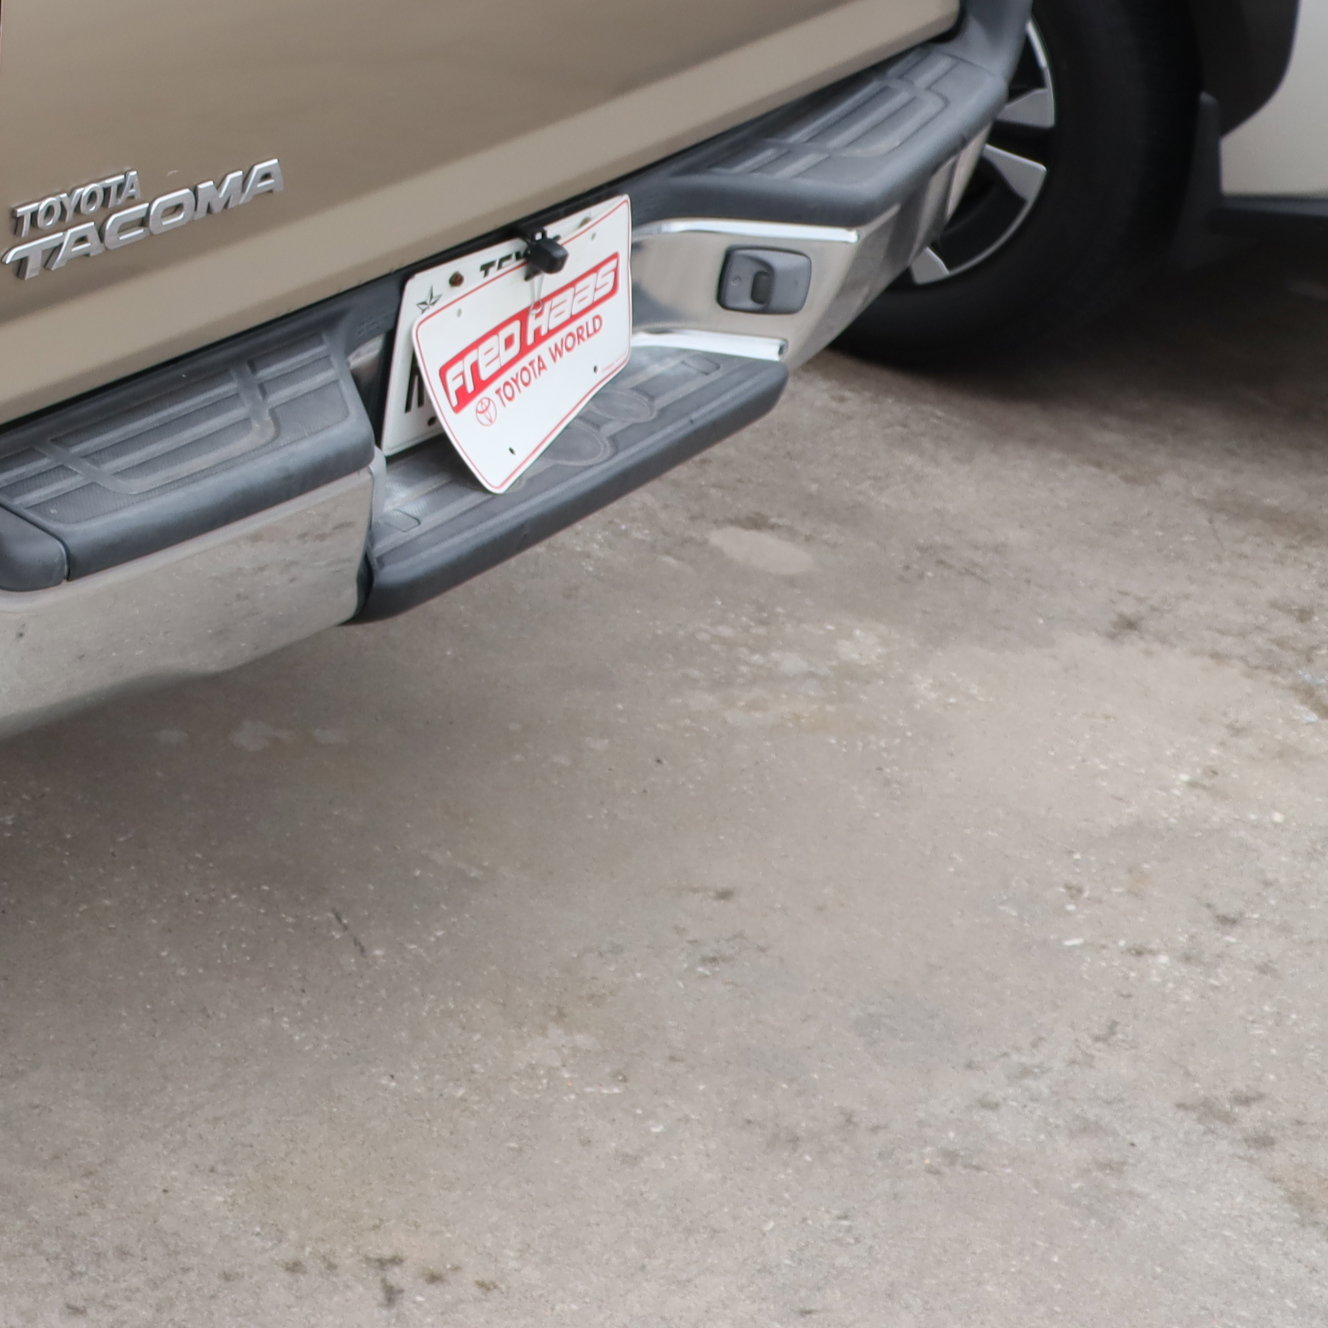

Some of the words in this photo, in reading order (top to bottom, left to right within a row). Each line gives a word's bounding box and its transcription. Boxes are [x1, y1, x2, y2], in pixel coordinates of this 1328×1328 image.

[0, 158, 284, 281] TACOMA
[12, 168, 142, 239] TOYOTA
[495, 355, 548, 408] TOYOTA
[549, 314, 604, 363] WORLD
